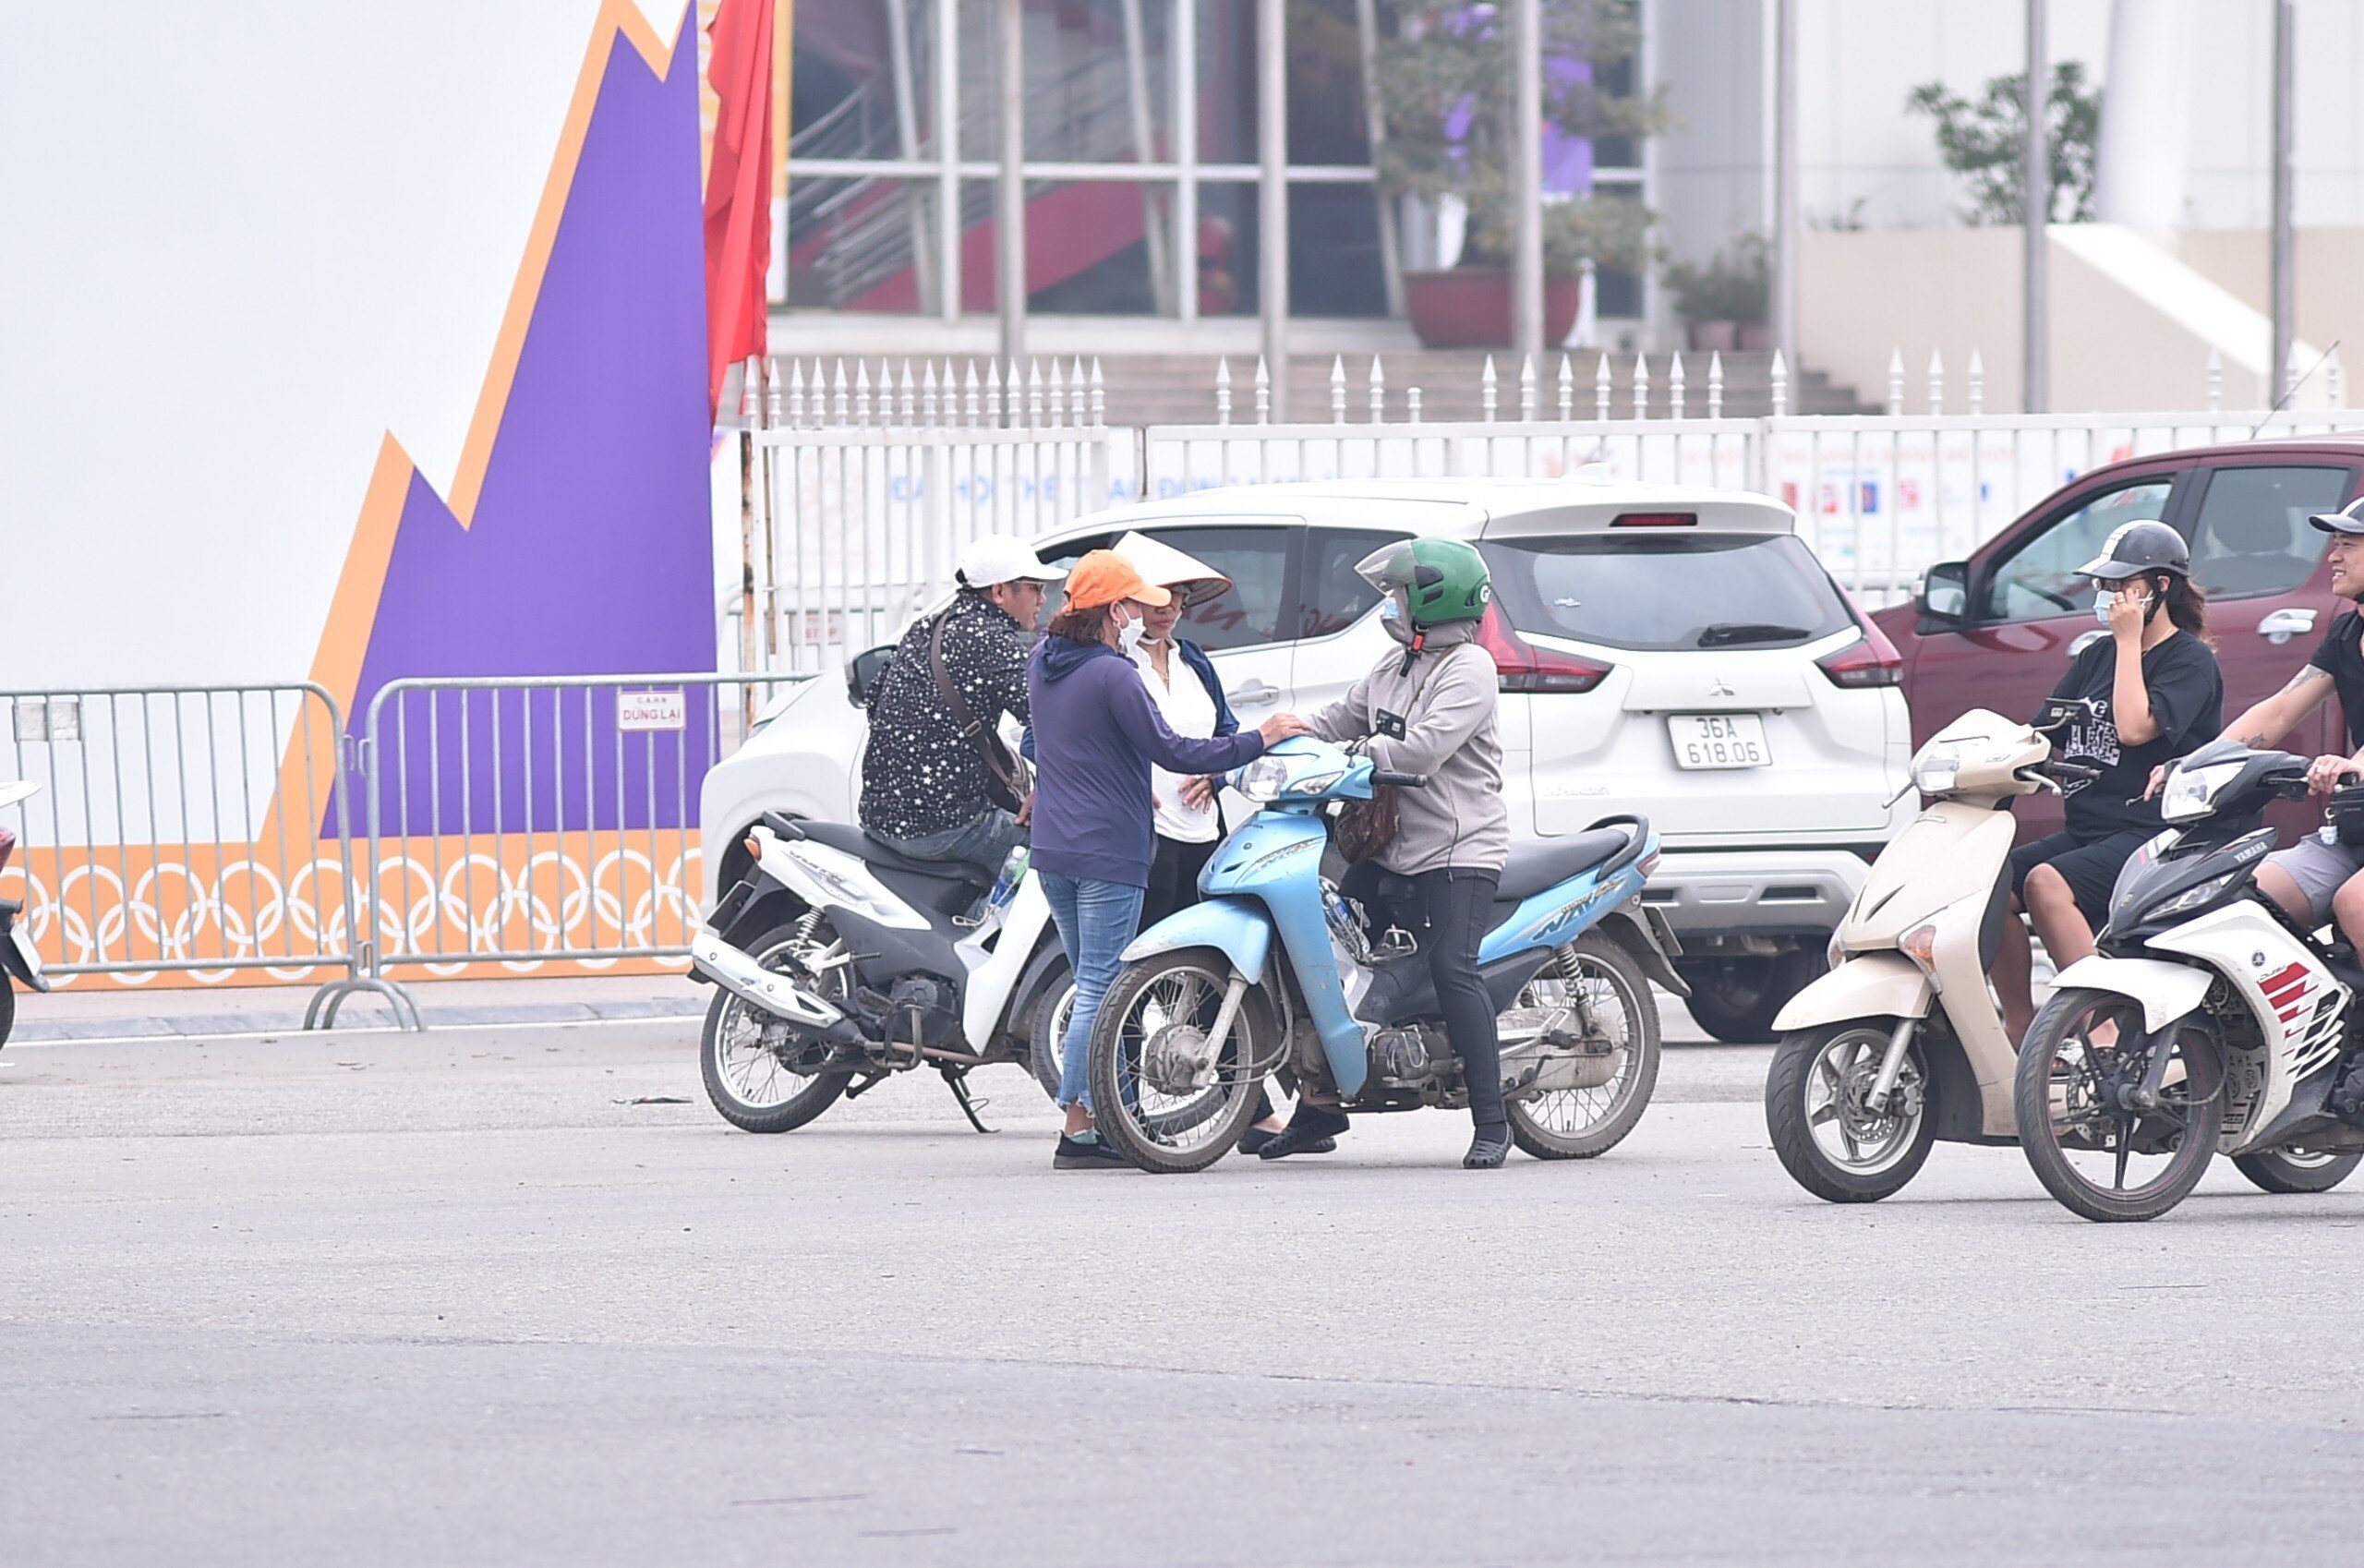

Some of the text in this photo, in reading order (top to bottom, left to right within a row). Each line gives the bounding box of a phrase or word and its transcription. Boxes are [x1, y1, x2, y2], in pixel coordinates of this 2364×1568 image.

[1696, 717, 1738, 739] 36A
[1687, 741, 1760, 765] 618.06
[2233, 840, 2268, 863] YAMAHA
